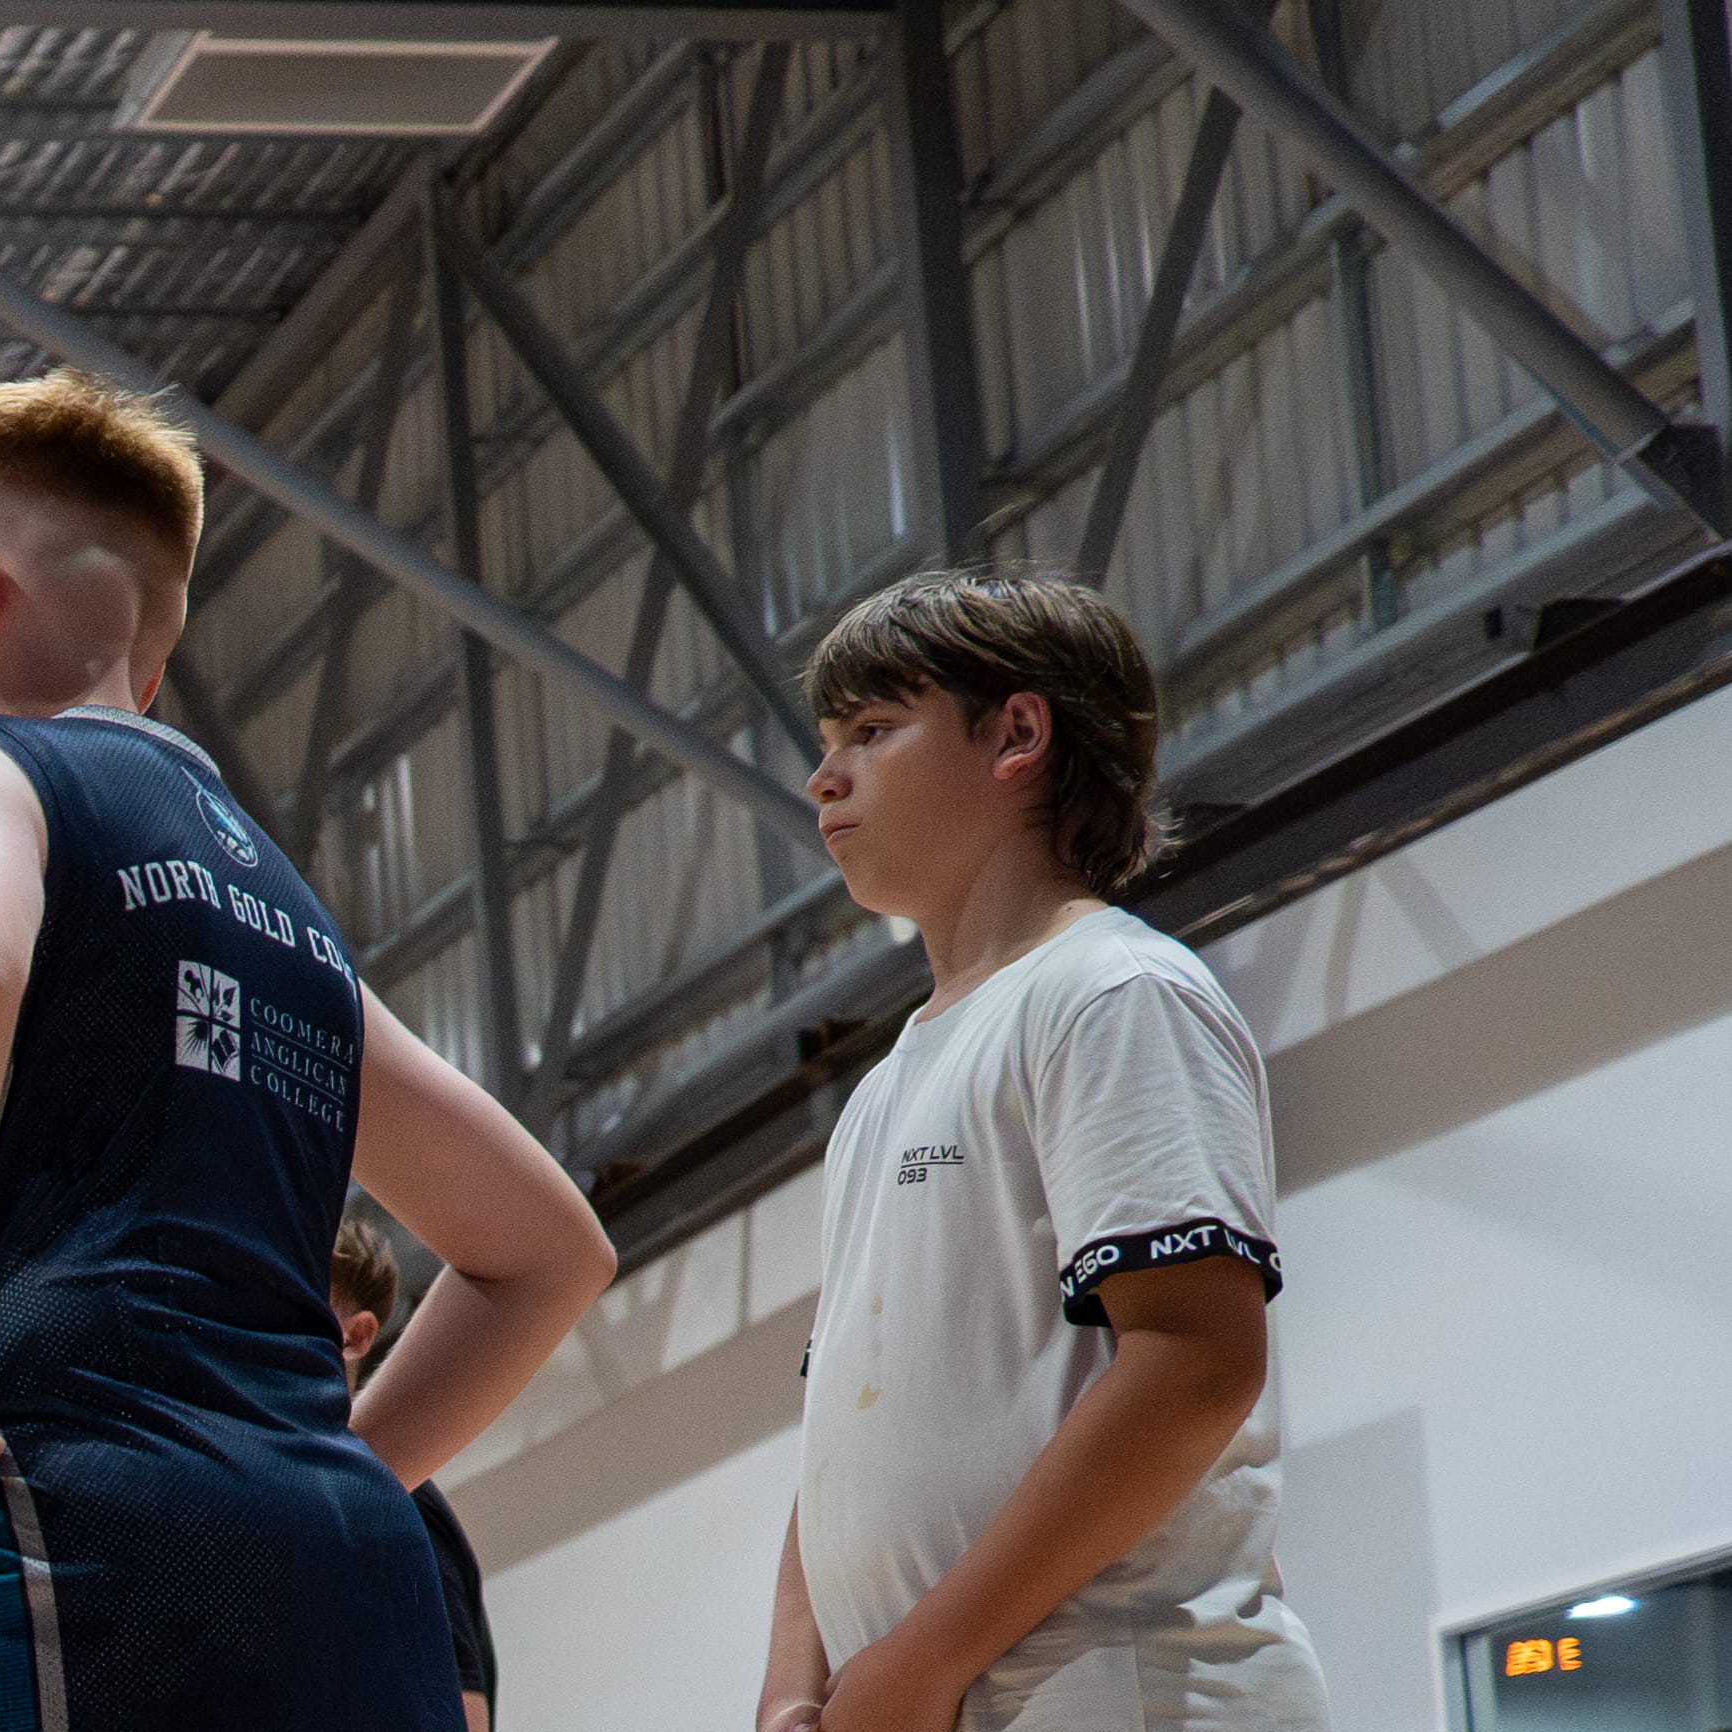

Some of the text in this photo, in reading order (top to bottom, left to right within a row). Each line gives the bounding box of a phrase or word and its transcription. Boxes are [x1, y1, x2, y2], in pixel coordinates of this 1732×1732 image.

[117, 860, 221, 911] NORTH
[228, 884, 295, 948] GOLD
[251, 998, 353, 1064] COOMERA
[251, 1031, 345, 1096] ANGLICAN
[251, 1065, 343, 1132] COLLEGE
[897, 1168, 927, 1185] 093
[901, 1145, 964, 1163] NXT LVL
[1075, 1245, 1120, 1283] EGO
[1149, 1225, 1218, 1259] NXT
